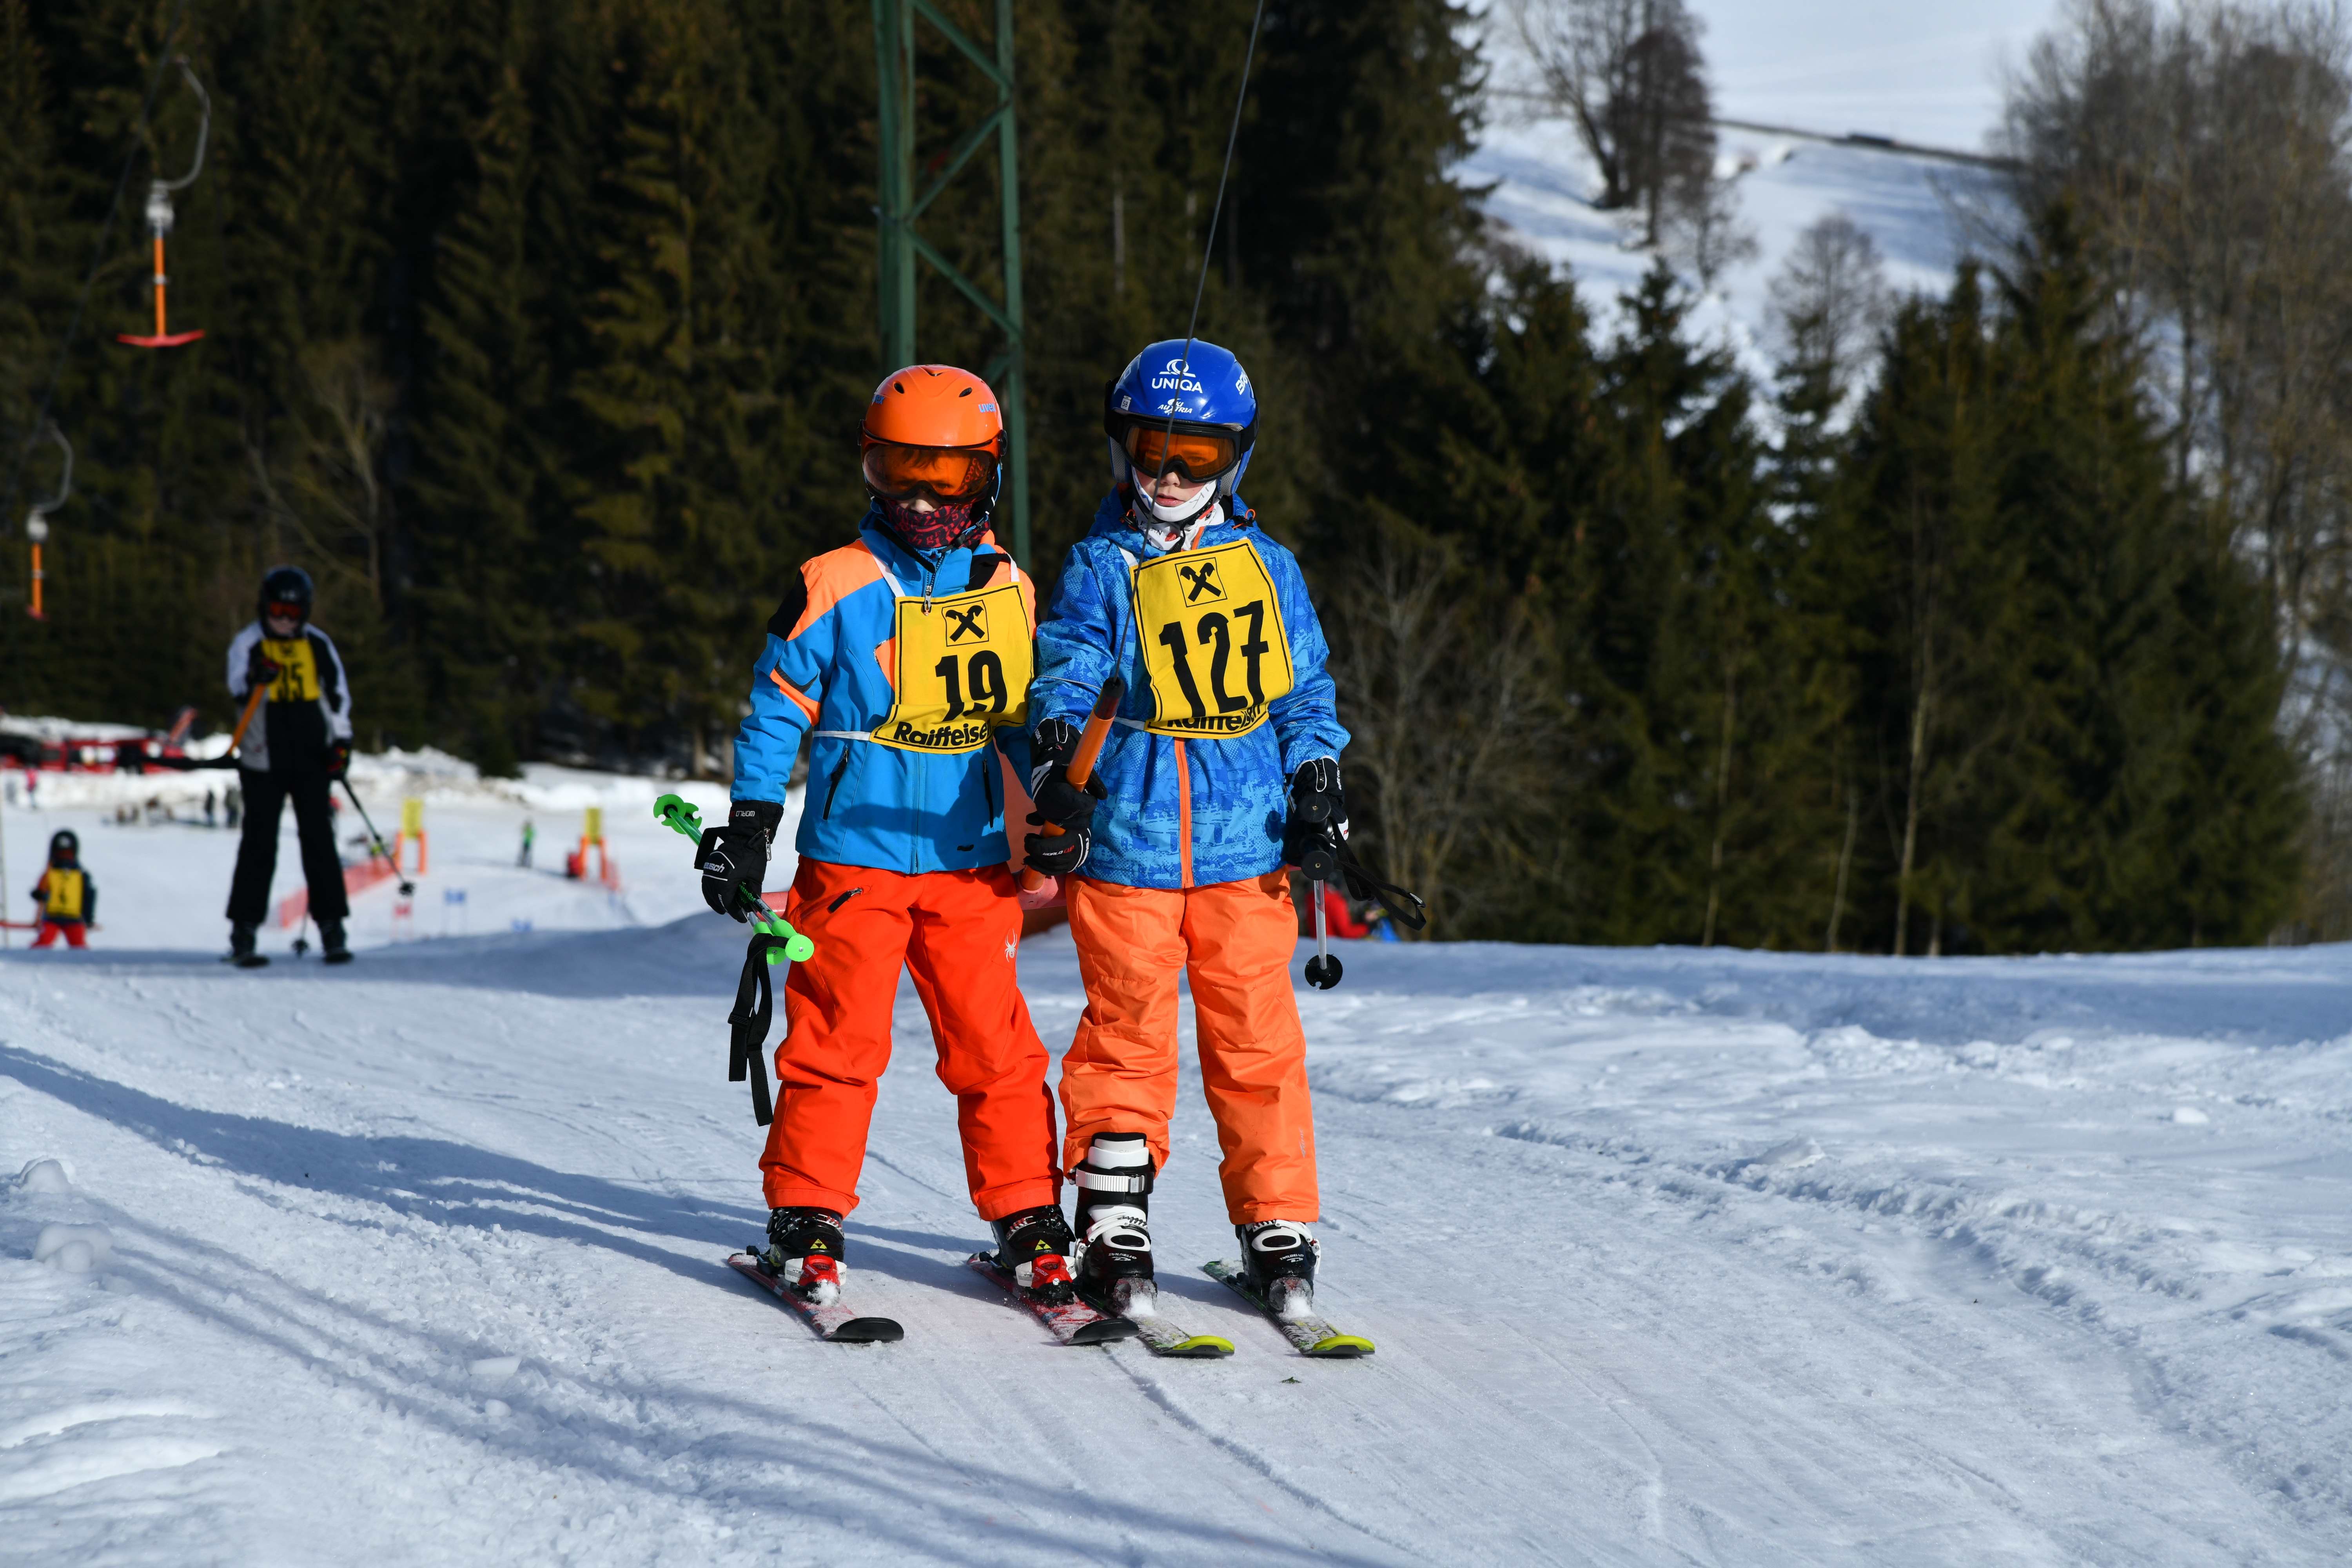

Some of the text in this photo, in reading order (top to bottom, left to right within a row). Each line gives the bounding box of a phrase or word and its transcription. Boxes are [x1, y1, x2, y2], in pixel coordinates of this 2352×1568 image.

[1152, 377, 1203, 394] UNIQA
[978, 403, 996, 413] uvex
[1158, 600, 1269, 717] 127
[935, 650, 1007, 722] 19
[1063, 845, 1075, 854] CUP
[703, 862, 725, 873] eusch
